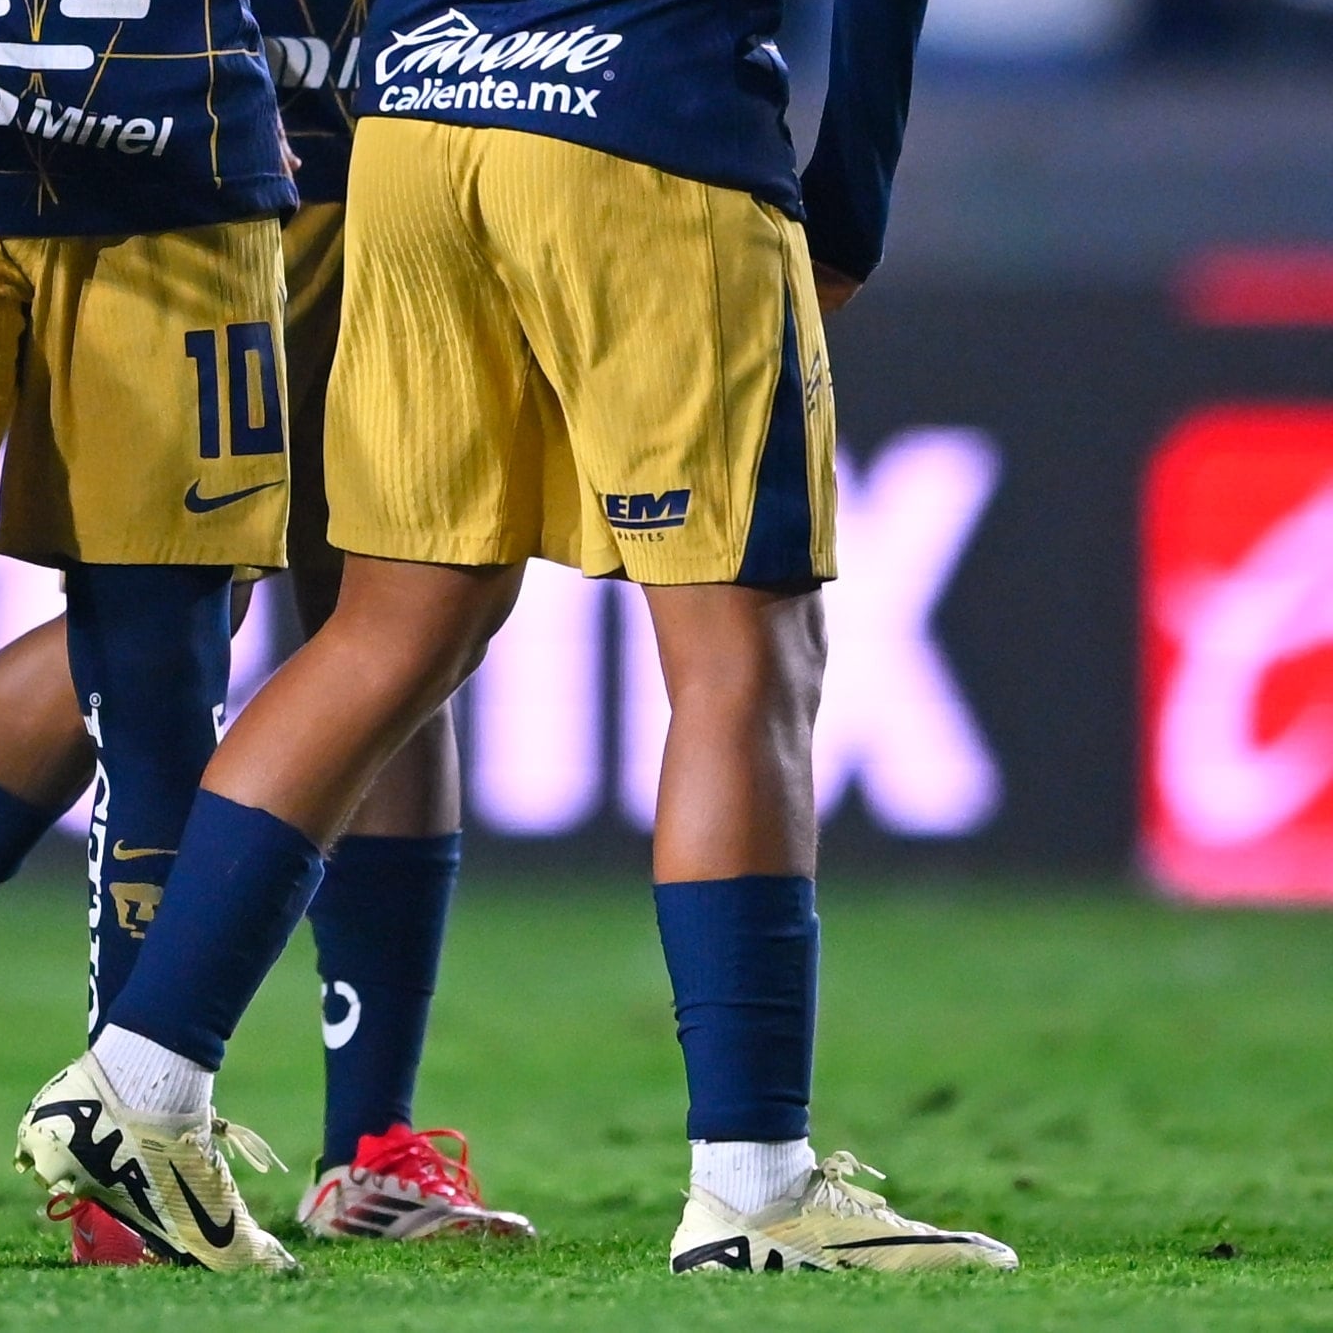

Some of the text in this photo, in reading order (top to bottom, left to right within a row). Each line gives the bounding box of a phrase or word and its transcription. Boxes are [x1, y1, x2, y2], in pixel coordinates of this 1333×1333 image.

[378, 75, 602, 119] caliente.mx
[184, 321, 286, 459] 10
[605, 489, 691, 520] EM
